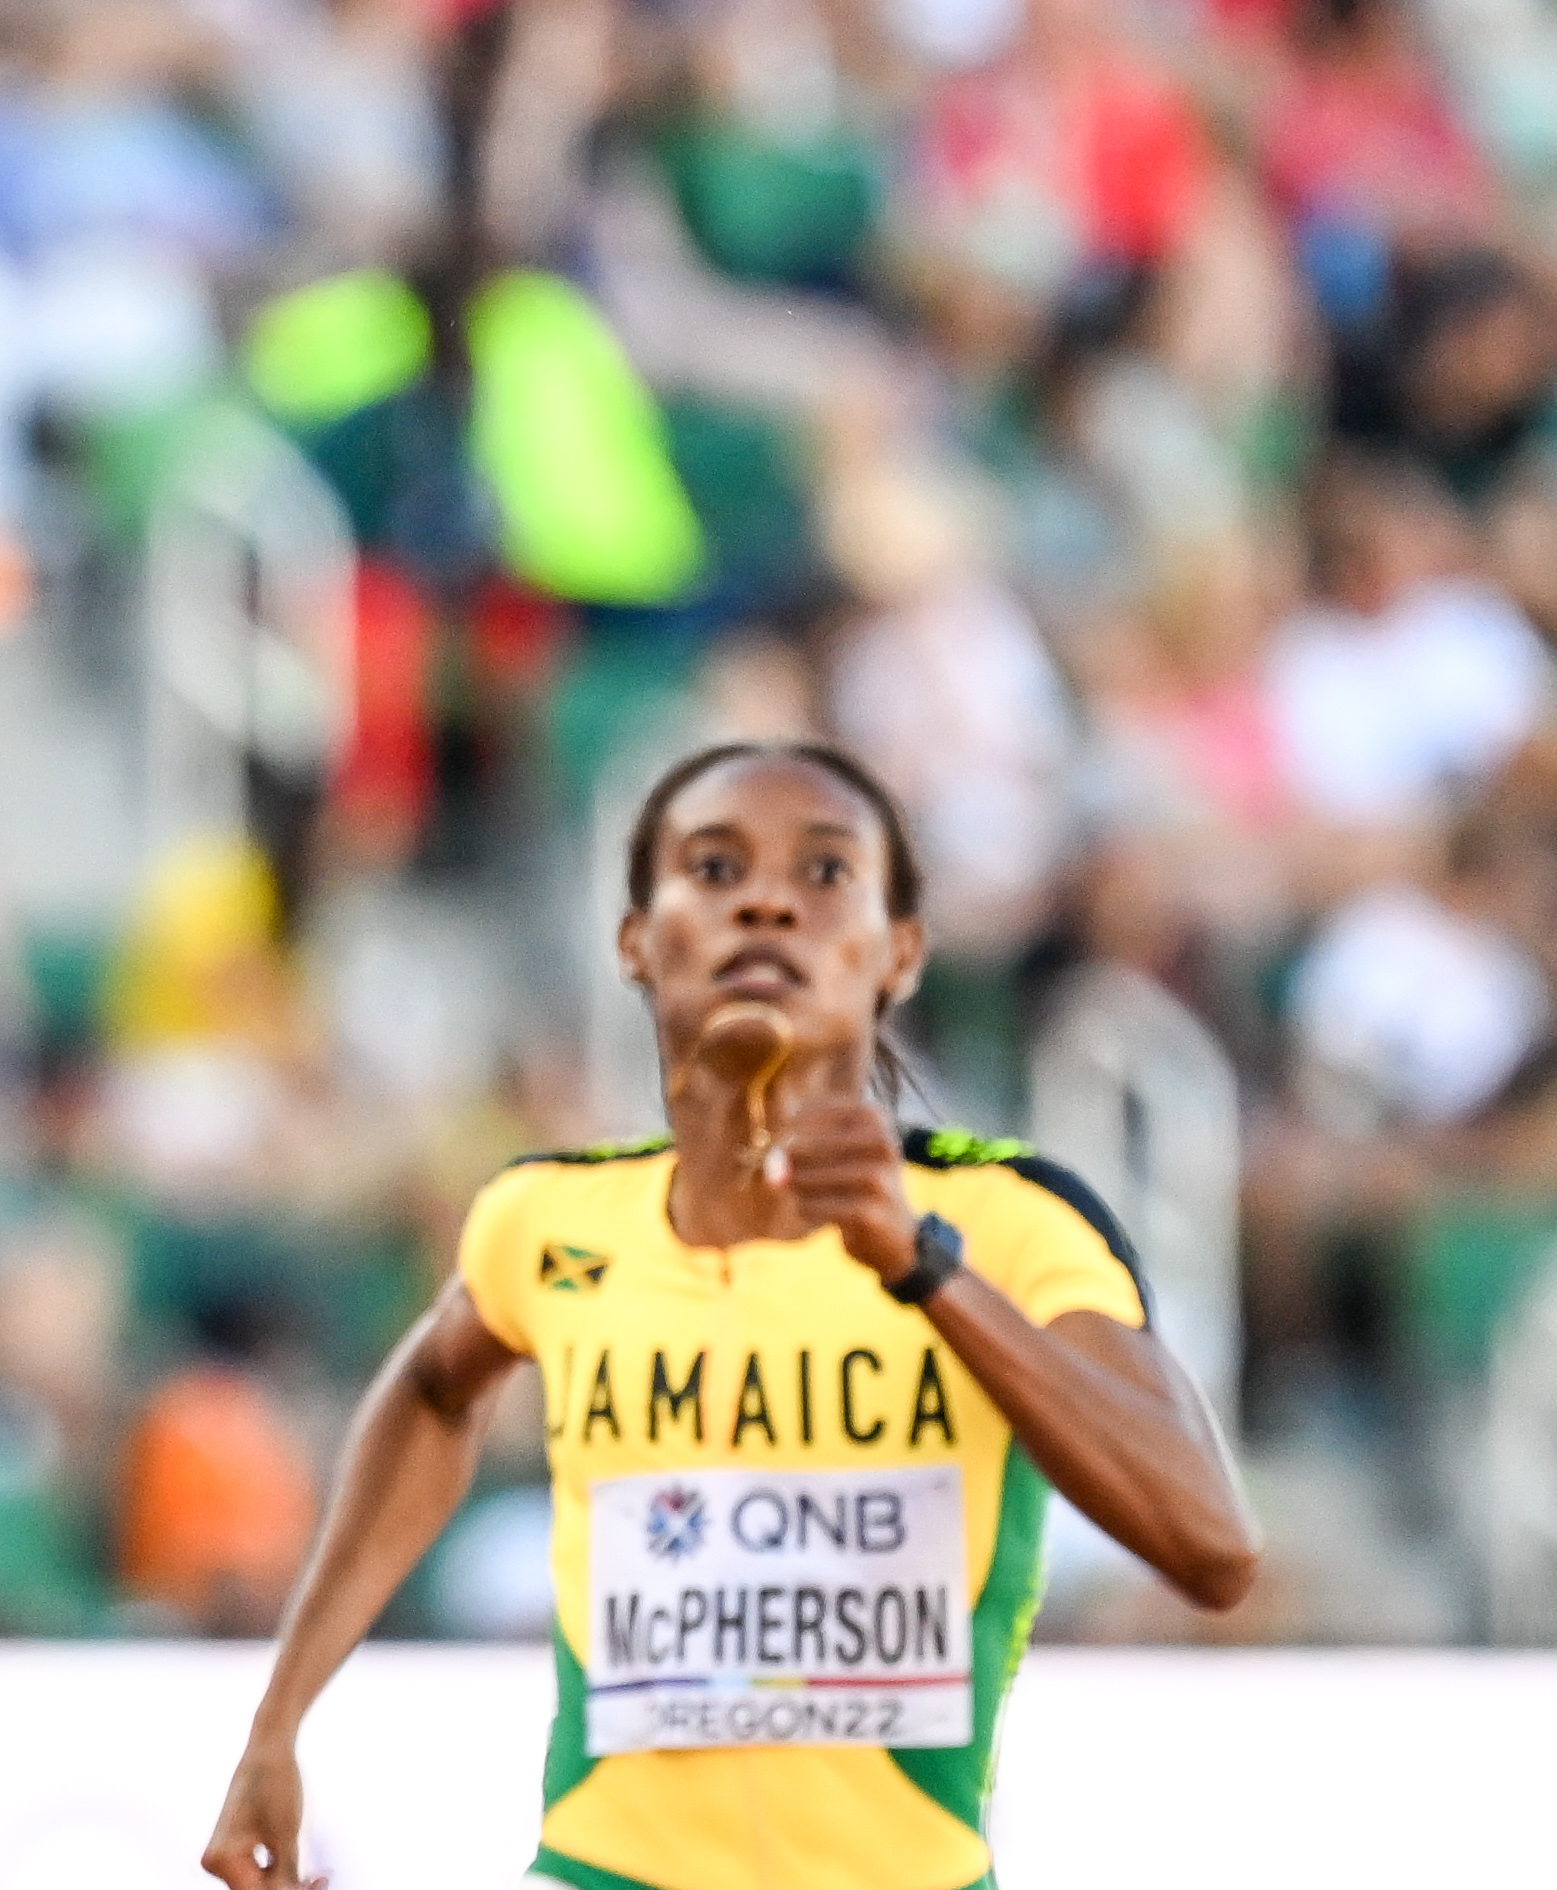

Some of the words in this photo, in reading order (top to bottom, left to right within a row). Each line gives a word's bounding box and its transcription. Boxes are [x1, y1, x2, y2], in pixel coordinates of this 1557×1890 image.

[546, 1346, 959, 1447] JAMAICA
[728, 1488, 908, 1554] QNB
[604, 1585, 949, 1672] McPHERSON
